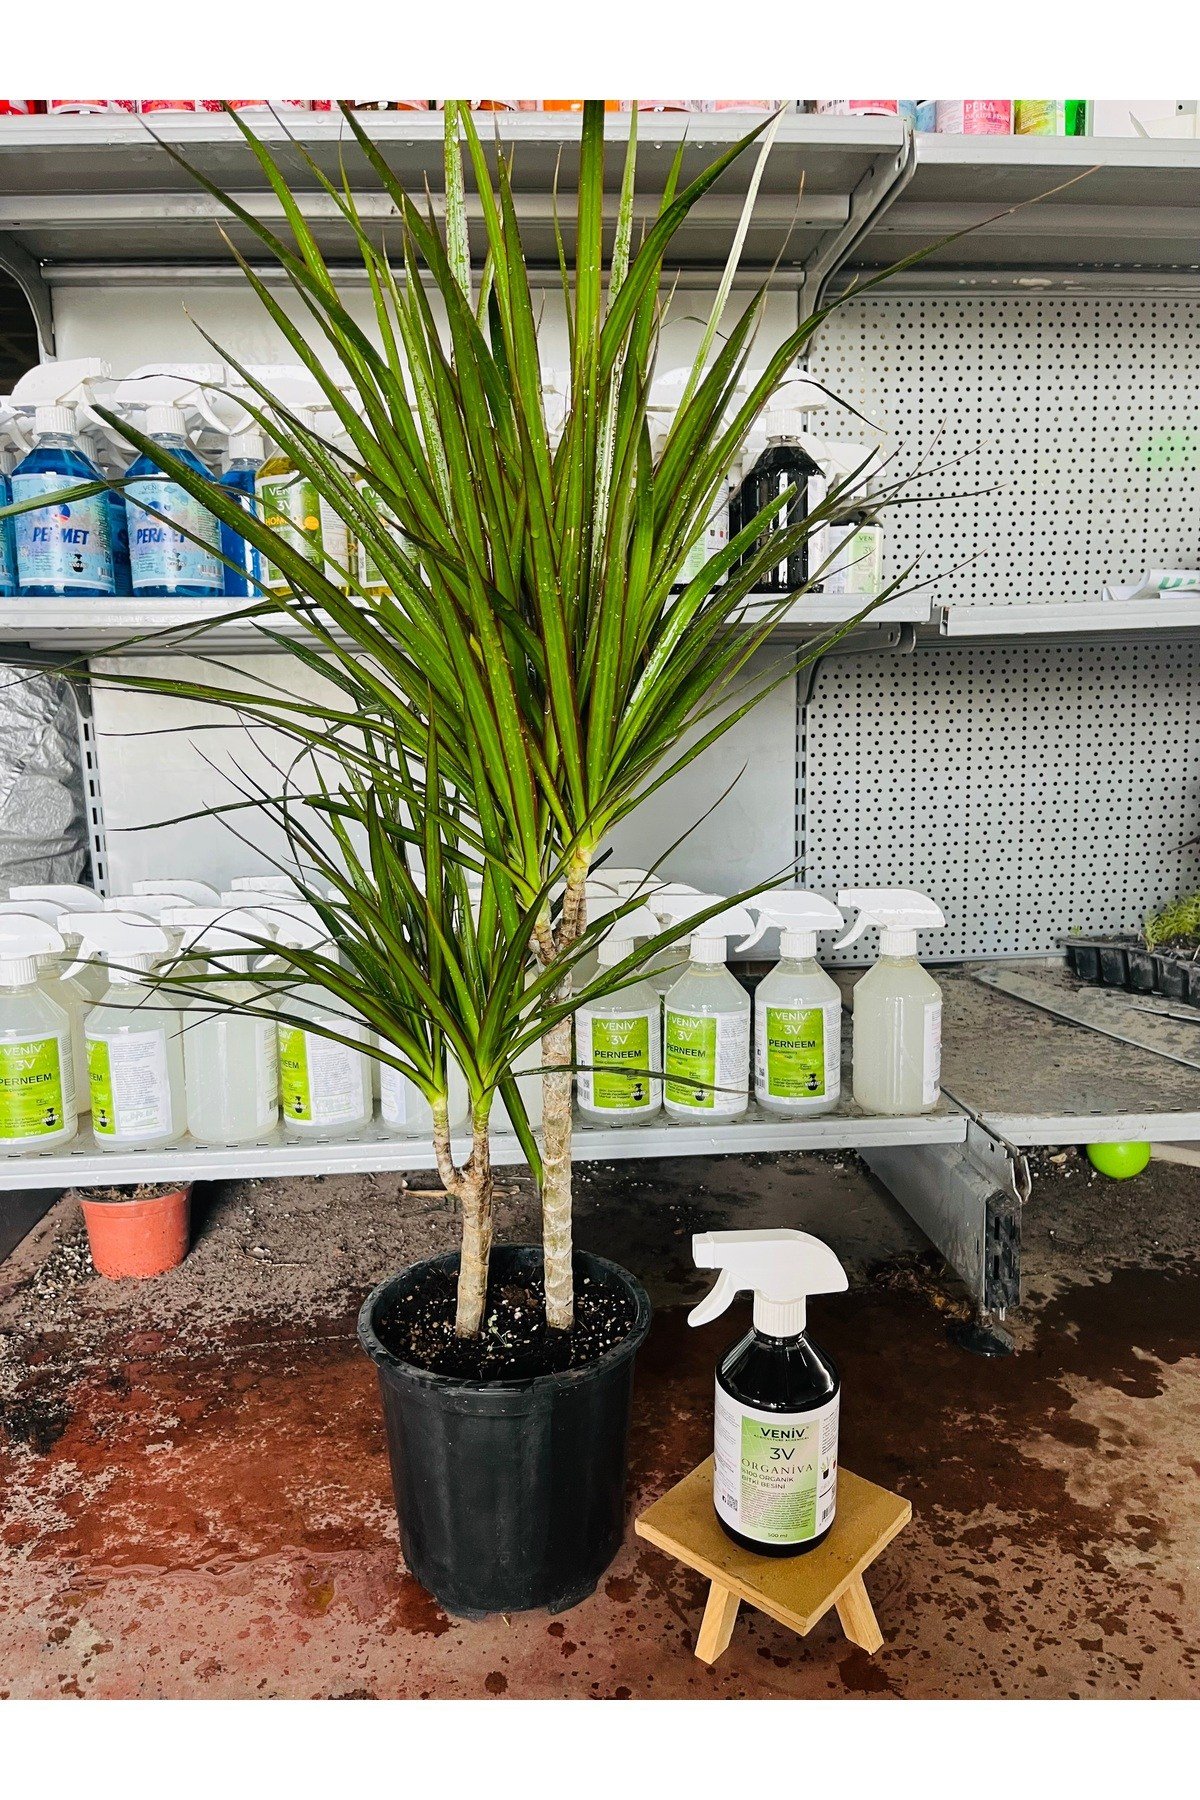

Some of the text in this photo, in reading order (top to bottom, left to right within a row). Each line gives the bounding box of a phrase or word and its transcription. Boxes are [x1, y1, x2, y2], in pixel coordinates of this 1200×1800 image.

[32, 527, 89, 545] PEMET
[784, 1024, 801, 1035] 3V
[611, 1035, 628, 1045] 3V
[678, 1031, 692, 1041] 3V
[769, 1040, 815, 1048] PERNEEM
[594, 1050, 642, 1059] PERNEEM
[666, 1043, 706, 1057] PERNEEM
[16, 1059, 36, 1070] 3V
[769, 1447, 795, 1461] 3V
[742, 1458, 813, 1475] ORGANİVA
